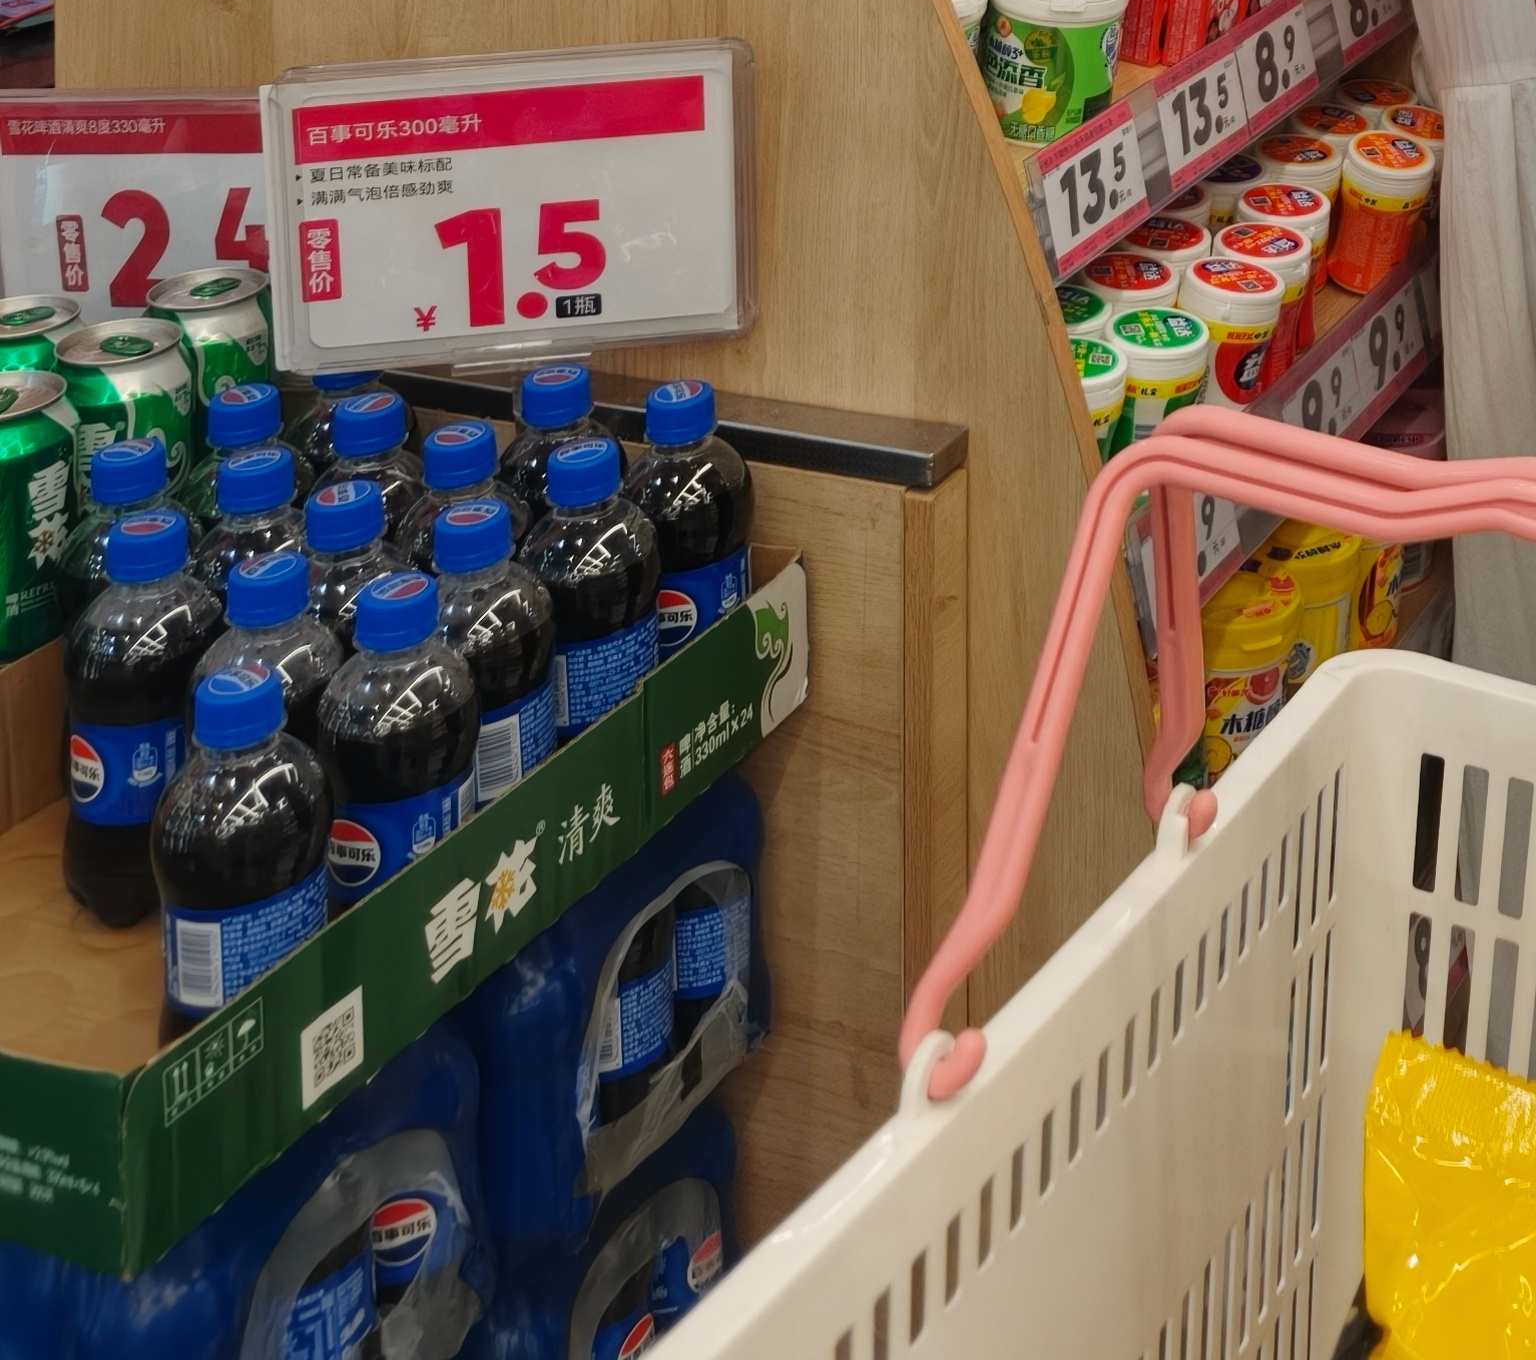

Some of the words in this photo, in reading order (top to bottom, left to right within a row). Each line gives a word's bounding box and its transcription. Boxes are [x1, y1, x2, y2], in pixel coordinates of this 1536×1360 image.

[1255, 24, 1296, 103] 8.9
[307, 113, 483, 146] 百事可乐300毫升
[1171, 71, 1229, 156] 13.5
[310, 157, 453, 184] 夏日常备美味标配
[311, 179, 454, 206] 满满气泡倍感劲爽
[1060, 140, 1126, 238] 13.5
[60, 220, 84, 287] 零售价
[307, 227, 334, 294] 零售价
[434, 199, 607, 327] 1.5
[562, 296, 597, 315] 1瓶
[27, 459, 72, 569] 雪花
[425, 836, 538, 985] 雪花
[558, 782, 621, 865] 清爽
